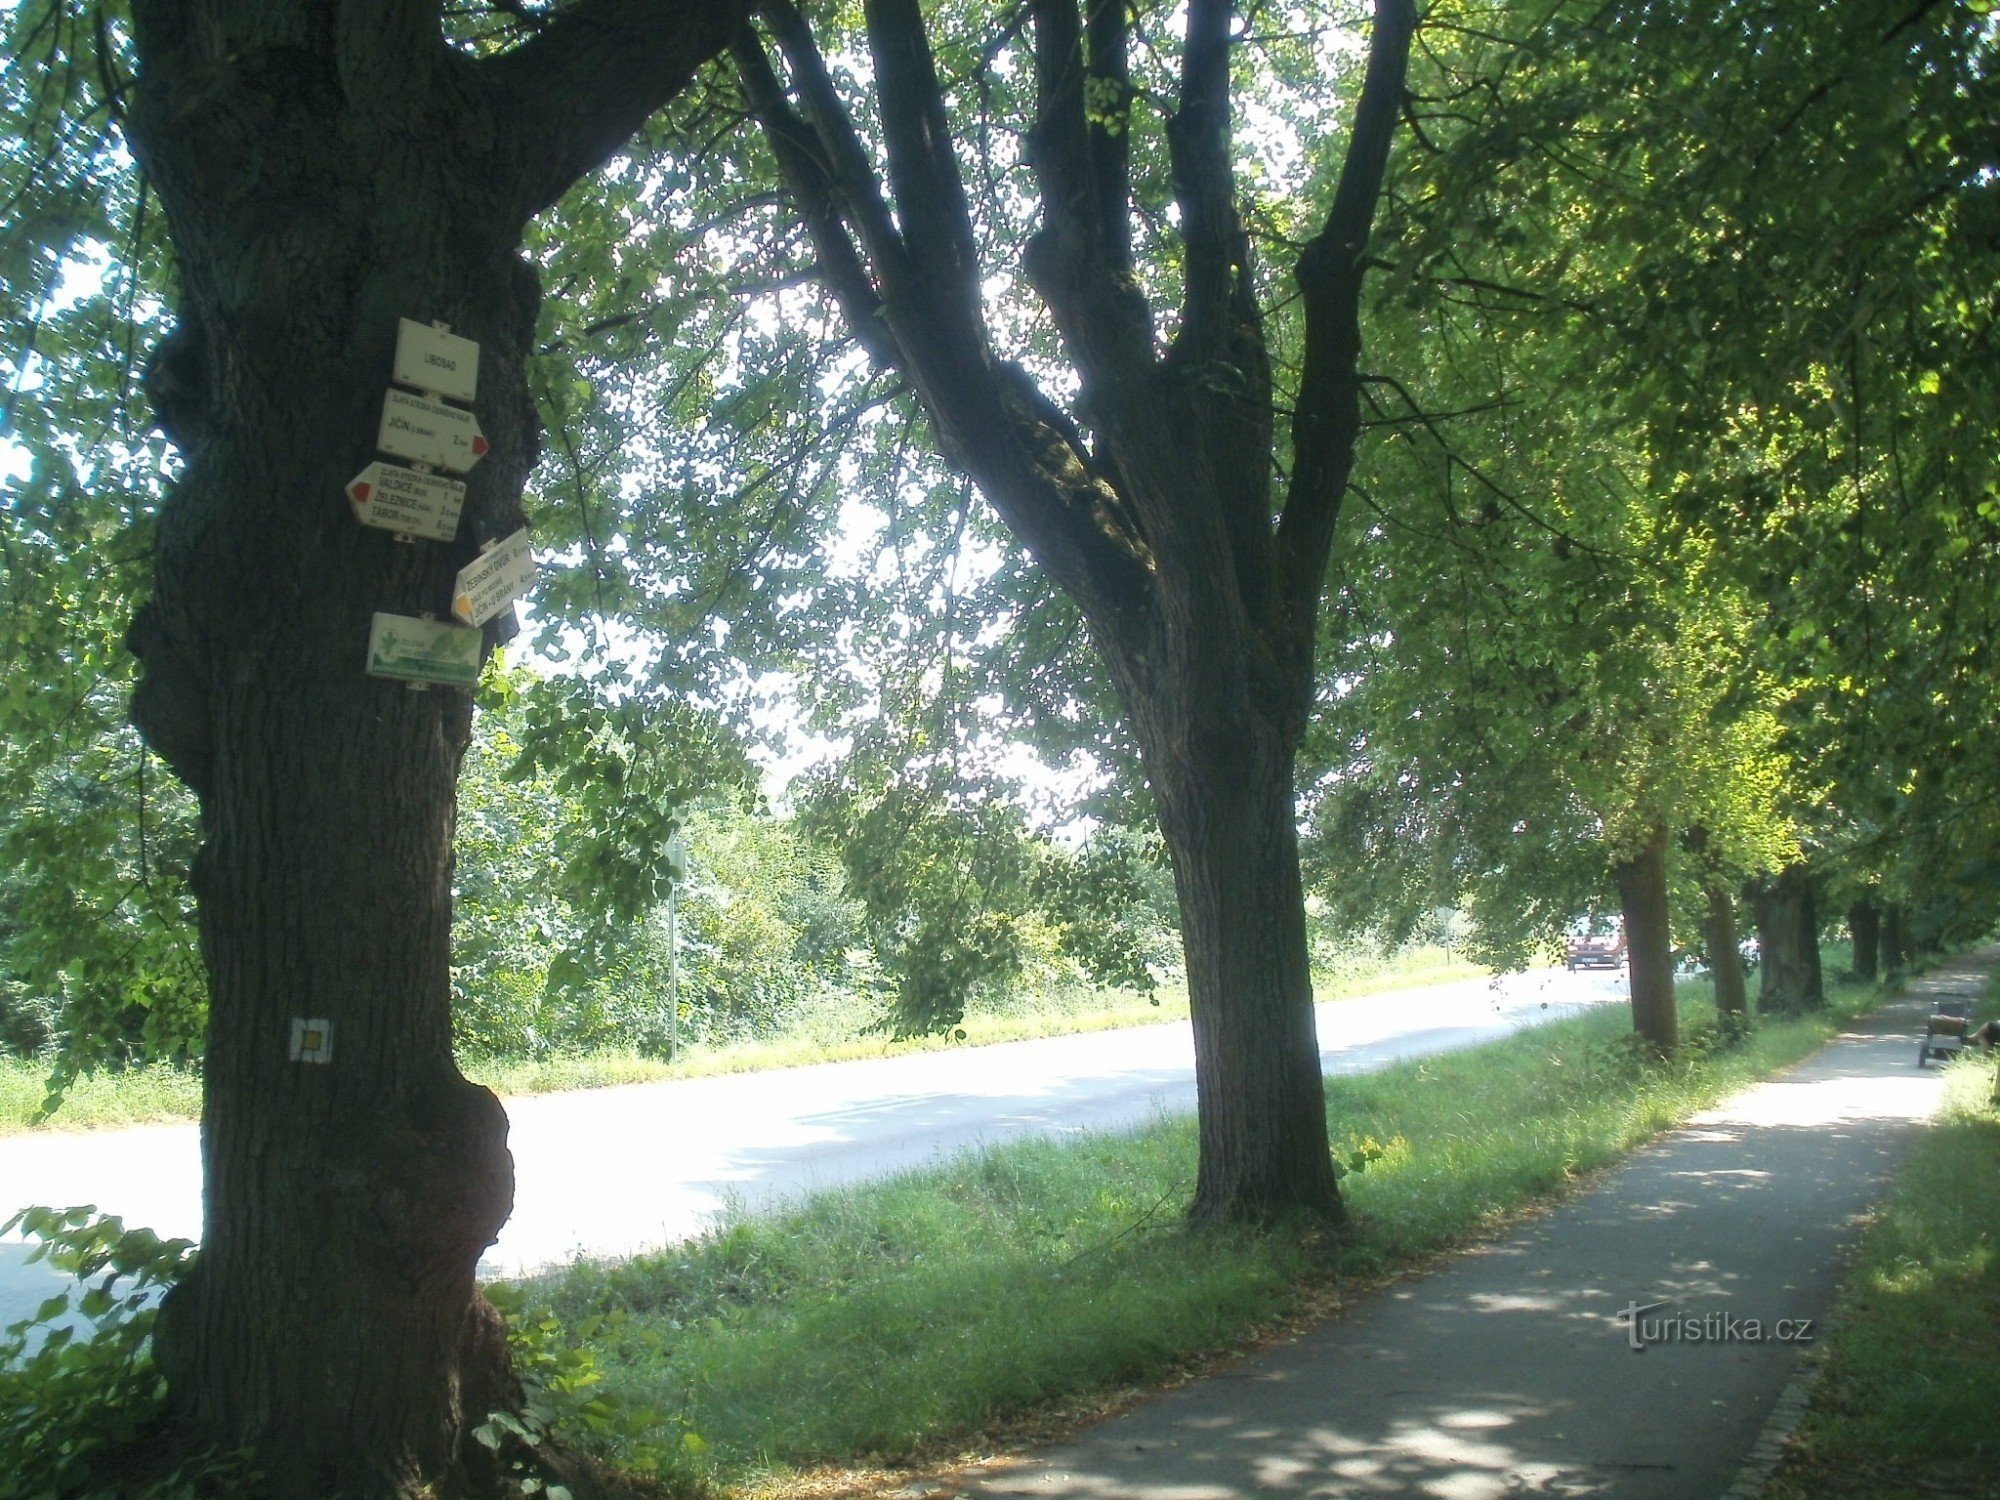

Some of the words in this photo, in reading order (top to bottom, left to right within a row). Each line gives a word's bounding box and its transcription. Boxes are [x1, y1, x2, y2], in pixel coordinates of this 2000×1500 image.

[424, 353, 457, 372] LIBOSAD
[388, 416, 409, 431] JIČÍN
[453, 434, 459, 445] 2
[379, 476, 413, 494] VALDICE
